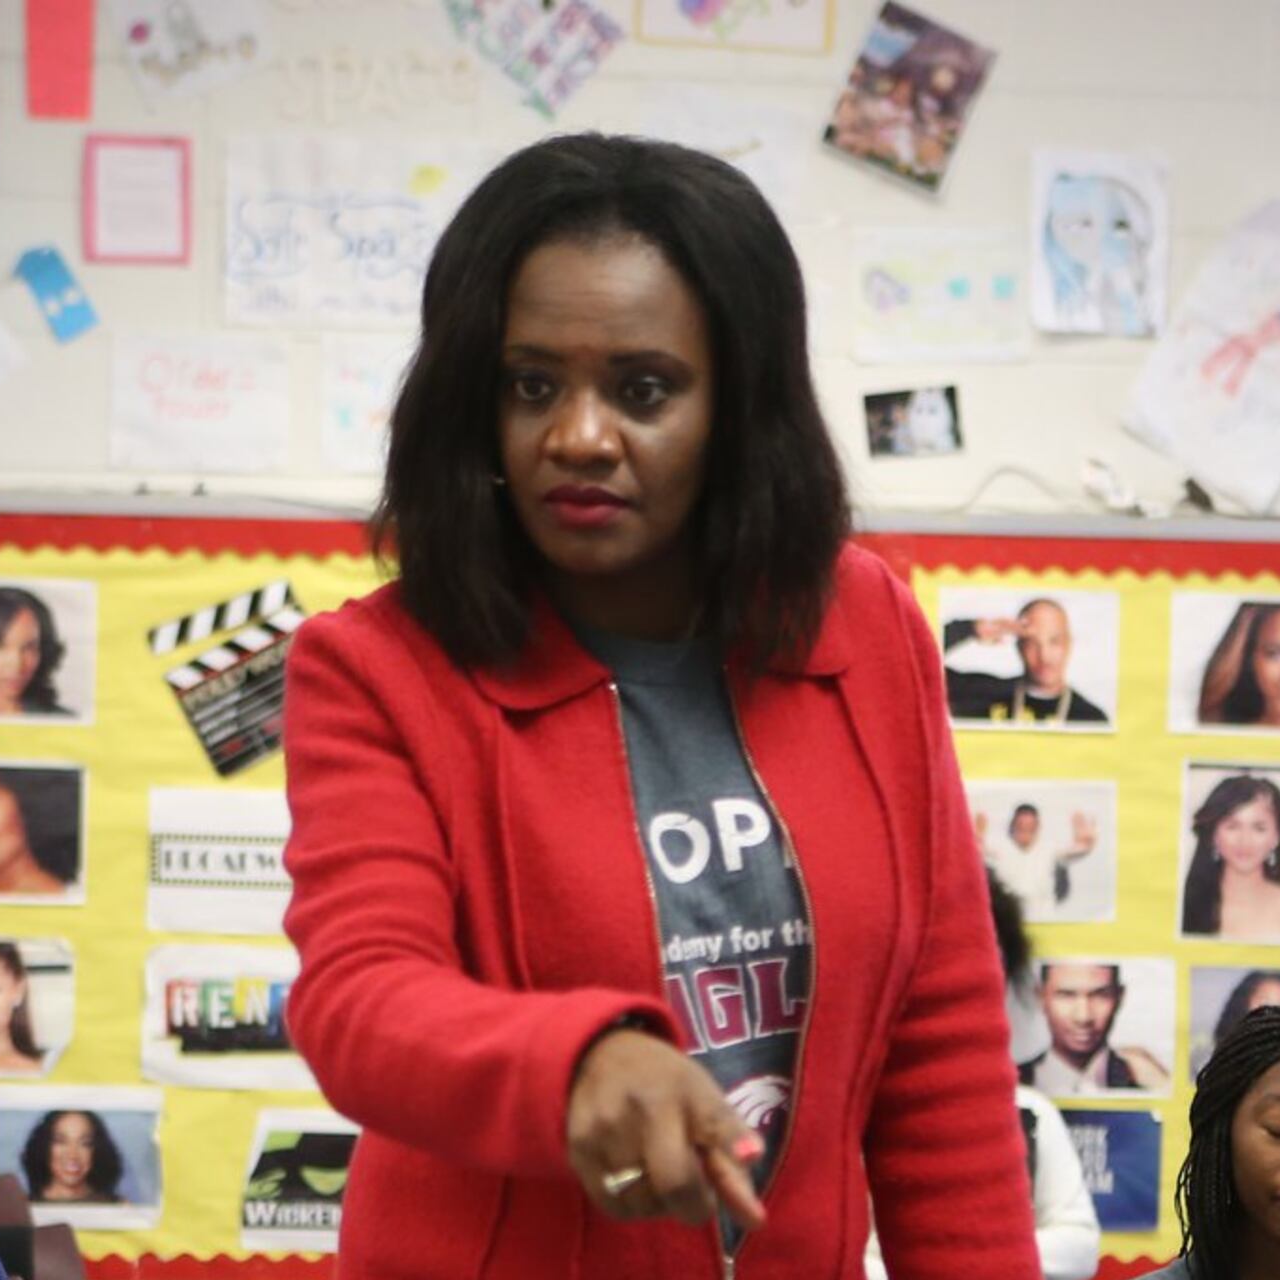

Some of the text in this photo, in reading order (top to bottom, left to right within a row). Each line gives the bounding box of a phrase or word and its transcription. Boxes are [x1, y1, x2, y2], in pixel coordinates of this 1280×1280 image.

[730, 925, 774, 953] for
[782, 918, 808, 946] th
[170, 981, 280, 1029] REN
